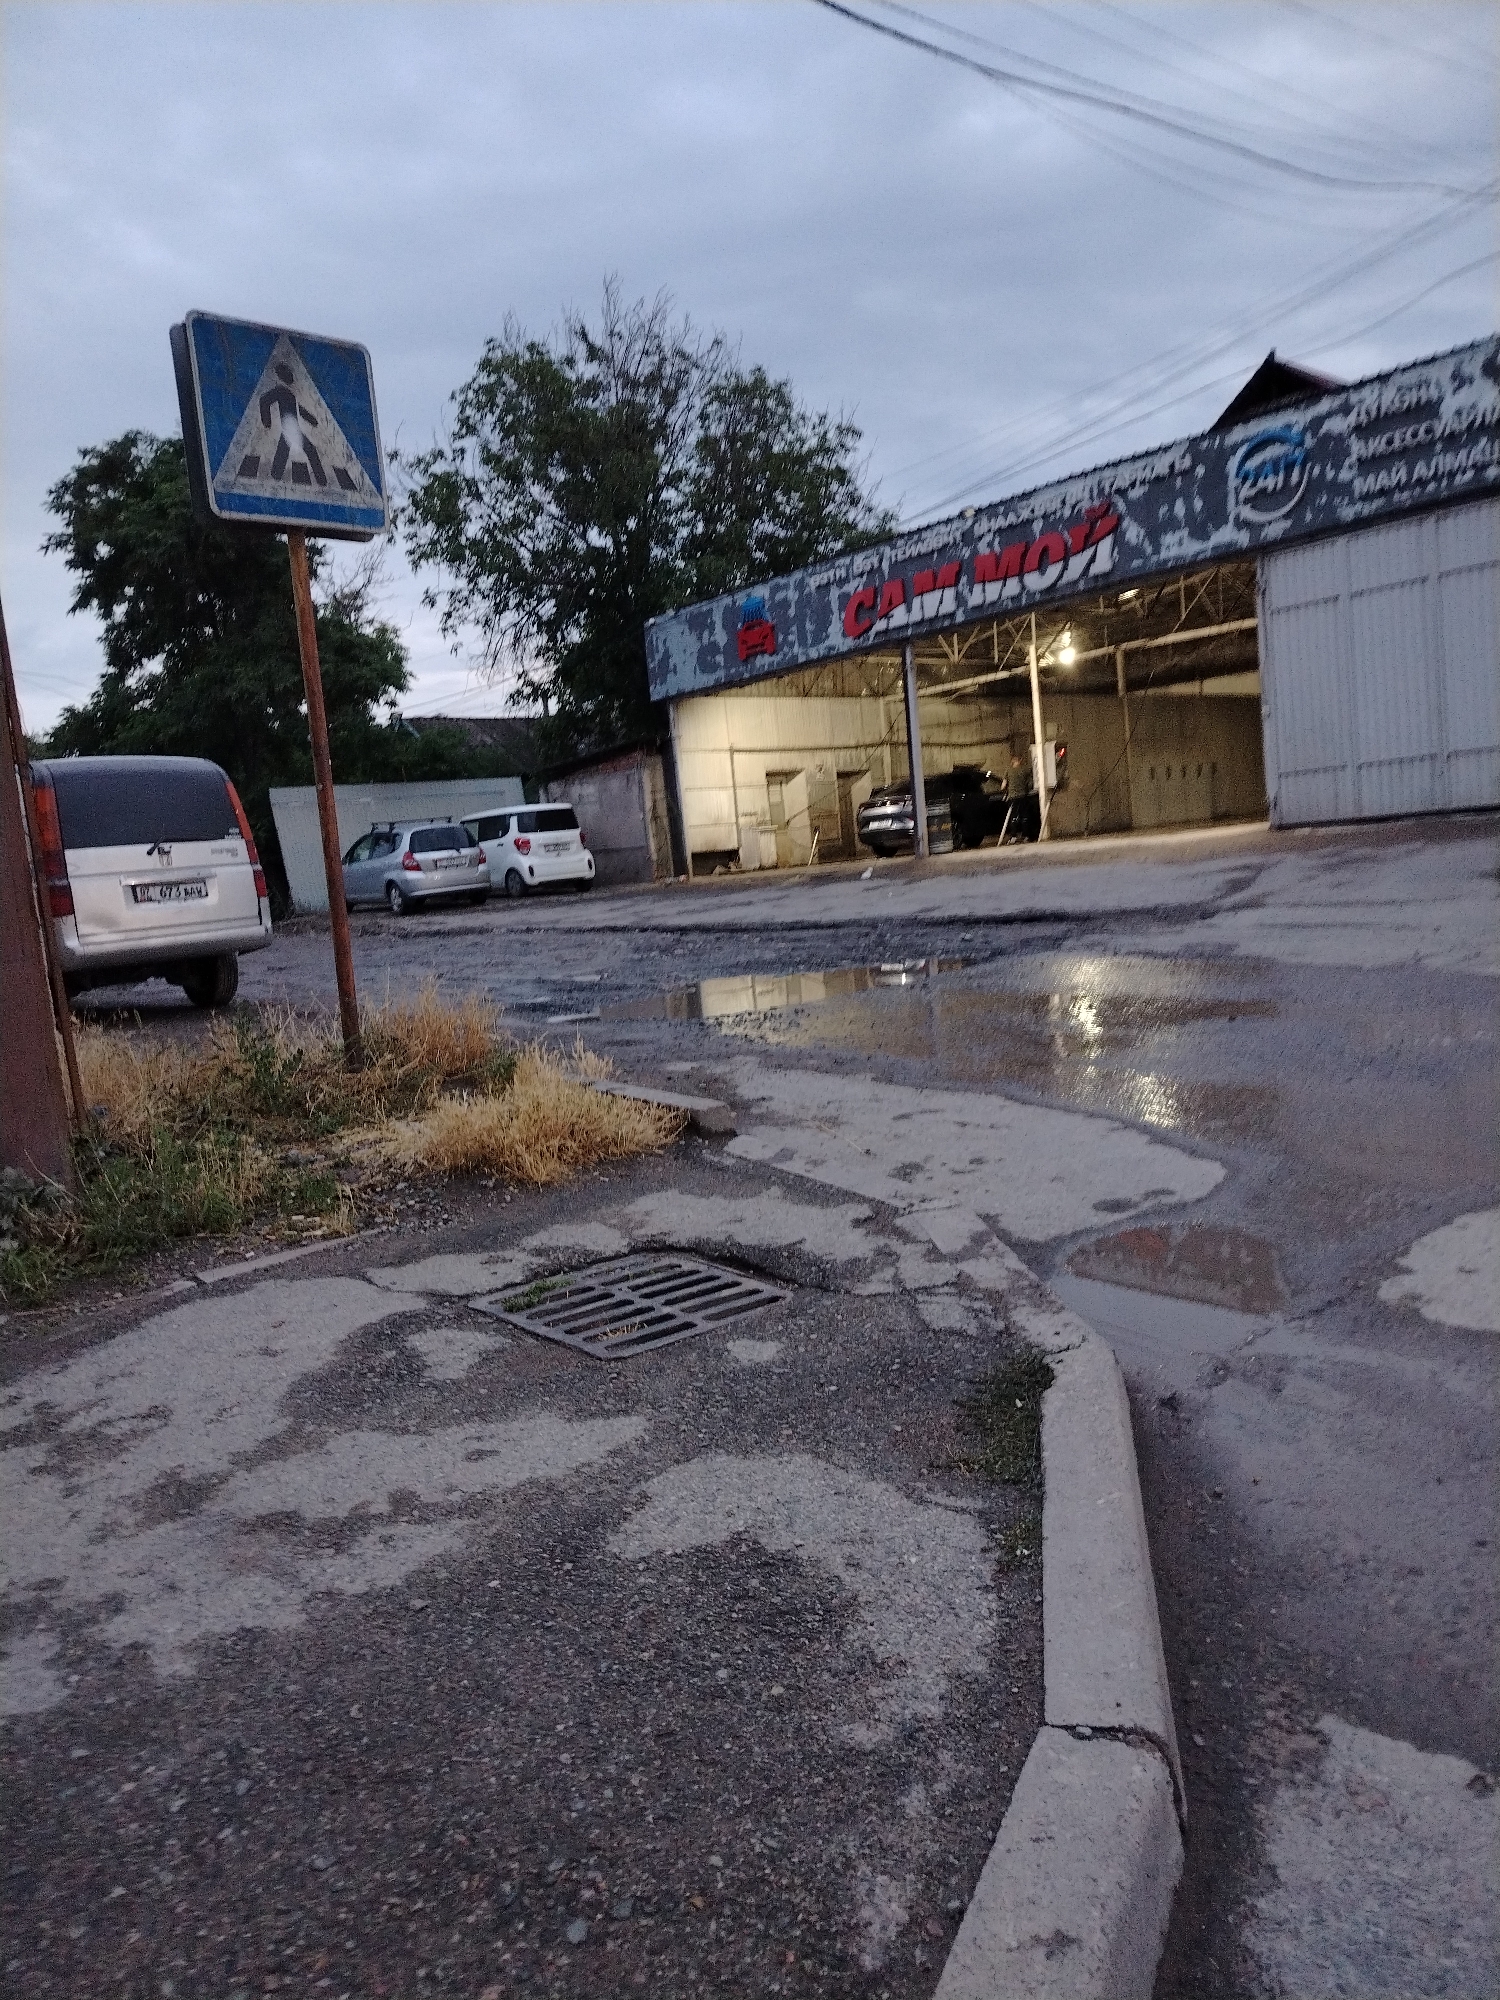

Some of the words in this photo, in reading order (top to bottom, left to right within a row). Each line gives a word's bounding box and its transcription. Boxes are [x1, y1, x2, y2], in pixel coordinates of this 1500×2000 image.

[1353, 459, 1408, 499] МАЙ
[843, 561, 962, 638] САМ
[968, 500, 1120, 609] МОЙ
